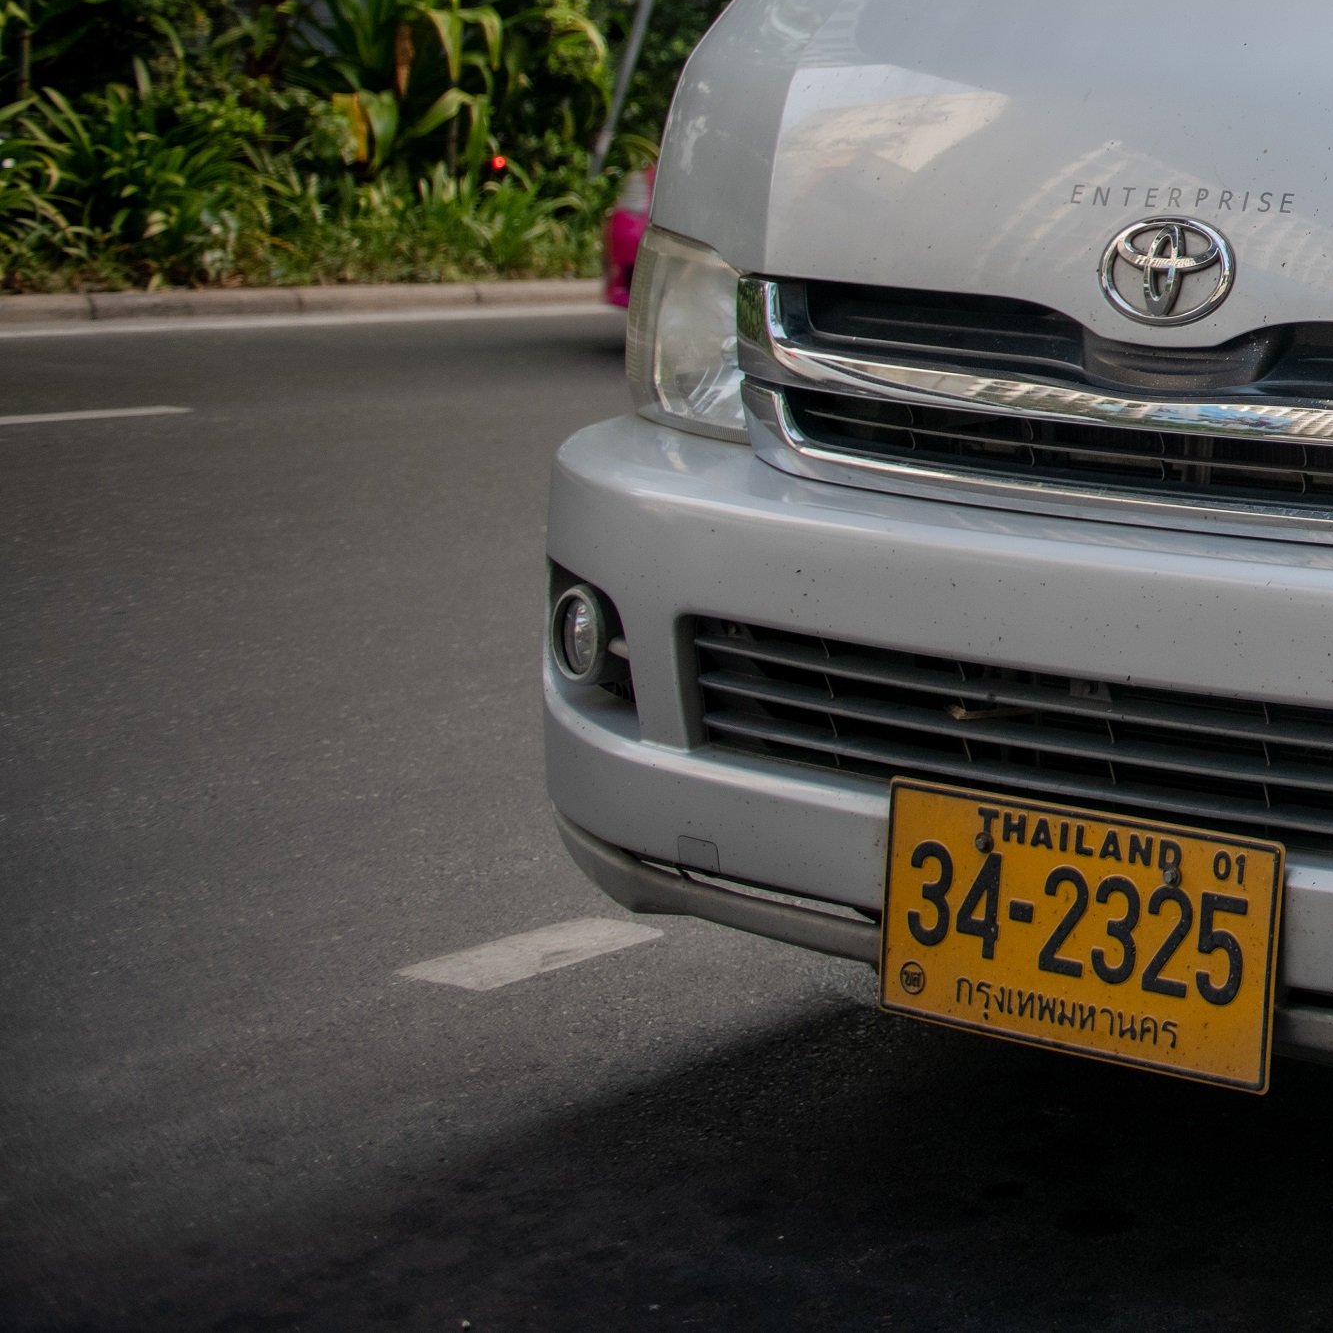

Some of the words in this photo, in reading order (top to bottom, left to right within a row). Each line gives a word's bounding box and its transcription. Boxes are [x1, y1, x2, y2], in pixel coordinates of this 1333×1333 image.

[1070, 184, 1296, 214] ENTERPRISE
[977, 806, 1183, 872] THAILAND
[1212, 850, 1247, 885] 01
[907, 840, 1249, 1007] 34-2325
[955, 975, 1179, 1050] กรุงเทพมหานคร
